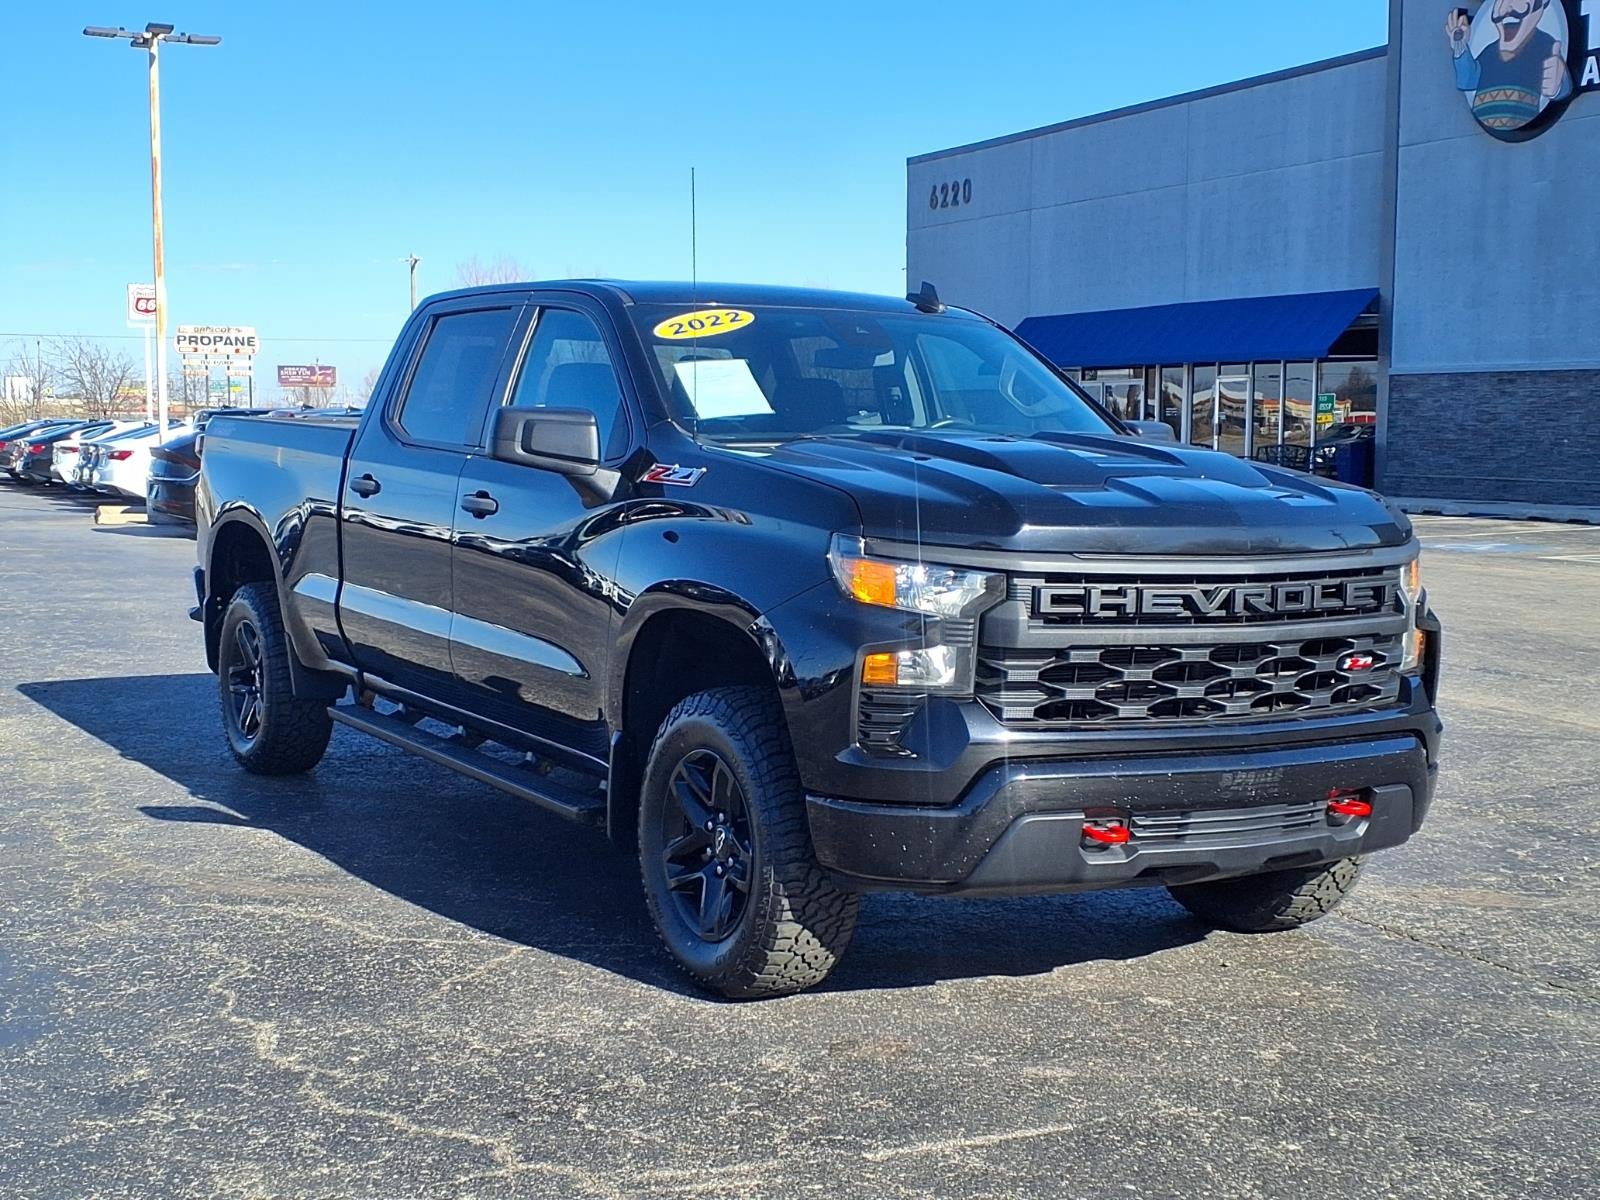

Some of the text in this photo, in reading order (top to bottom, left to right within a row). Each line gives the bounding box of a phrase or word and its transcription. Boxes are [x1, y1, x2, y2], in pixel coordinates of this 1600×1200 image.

[929, 178, 972, 210] 6220
[137, 299, 156, 311] 66
[668, 311, 744, 336] 2022
[176, 335, 256, 347] PROPANE
[642, 463, 707, 487] Z71
